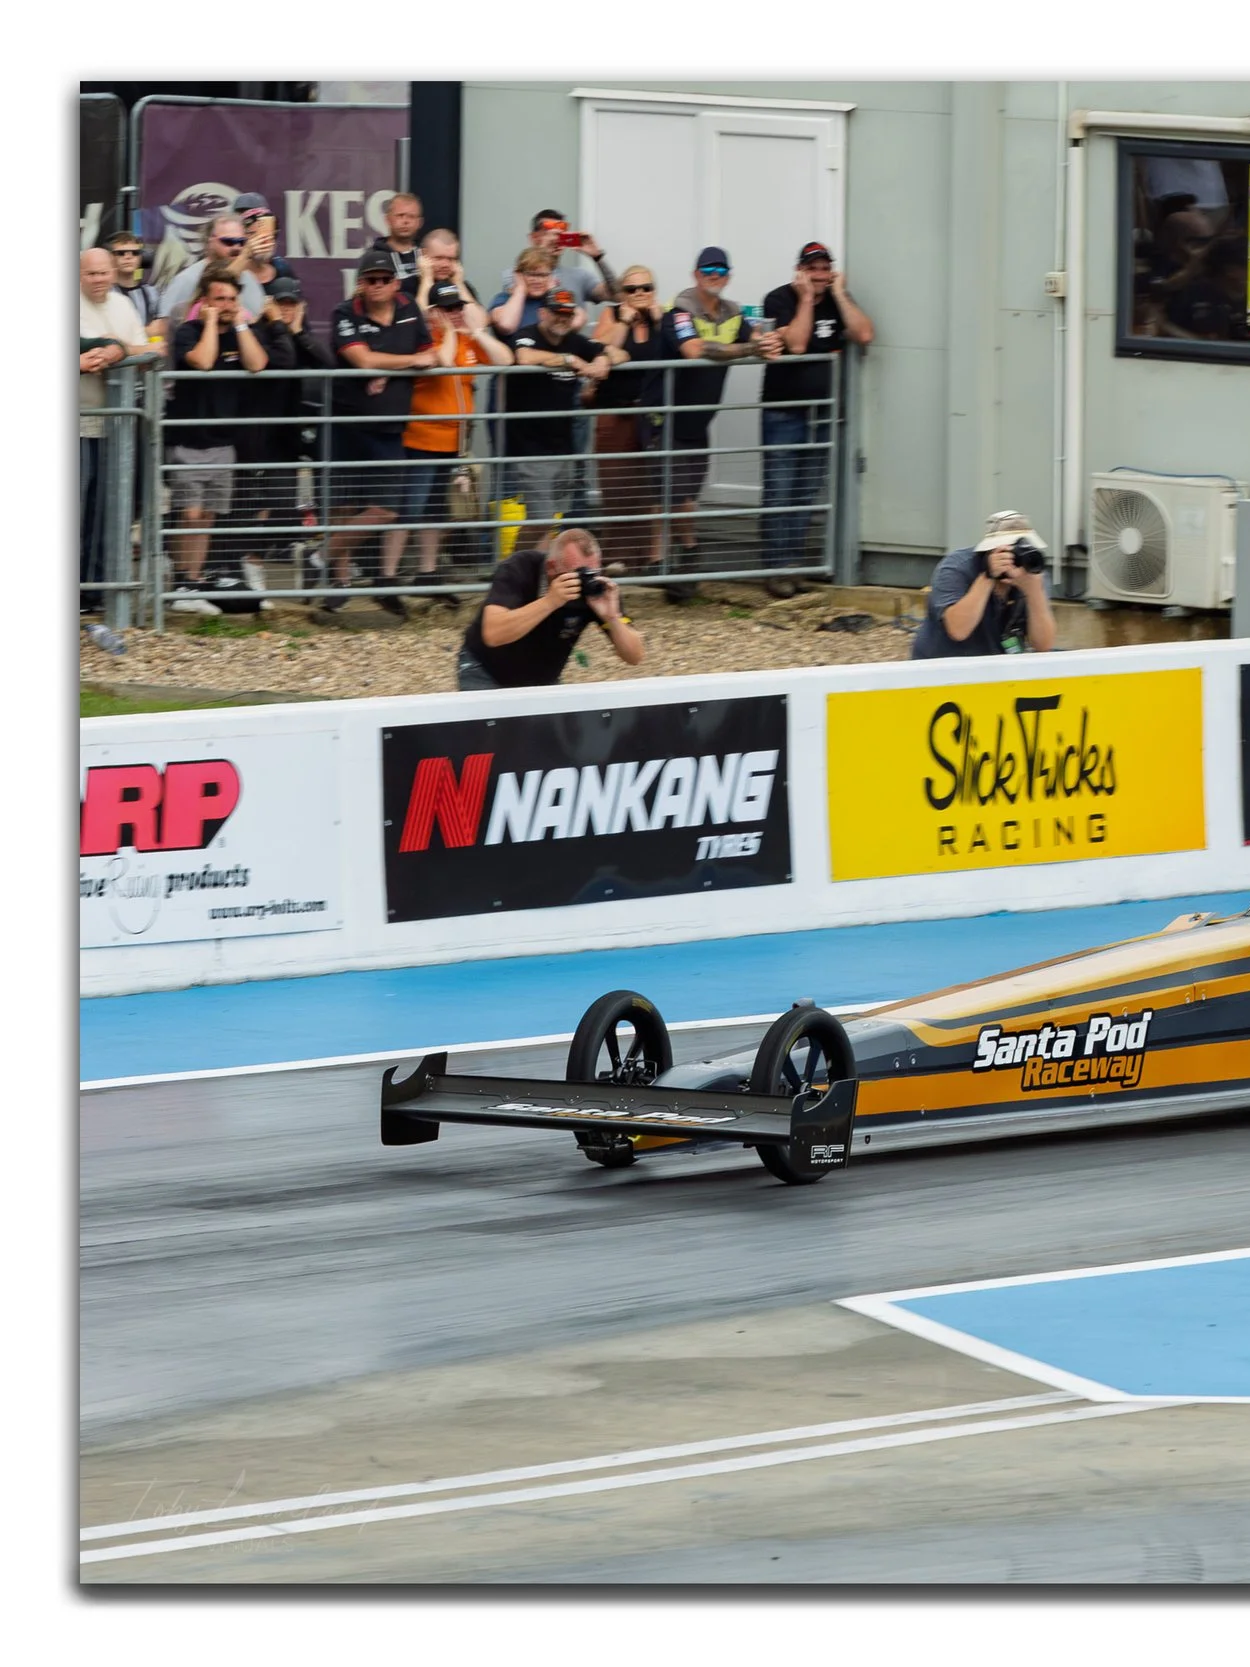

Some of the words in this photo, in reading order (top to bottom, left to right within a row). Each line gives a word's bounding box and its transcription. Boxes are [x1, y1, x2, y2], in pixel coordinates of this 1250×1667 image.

[80, 758, 244, 857] RP
[484, 749, 780, 846] NANKANG
[695, 831, 764, 861] TYRES
[937, 813, 1108, 857] RACING
[164, 863, 251, 899] products
[973, 1026, 1077, 1068] Santa
[1083, 1011, 1153, 1056] Pod
[1022, 1053, 1144, 1088] Raceway
[810, 1144, 845, 1159] RF
